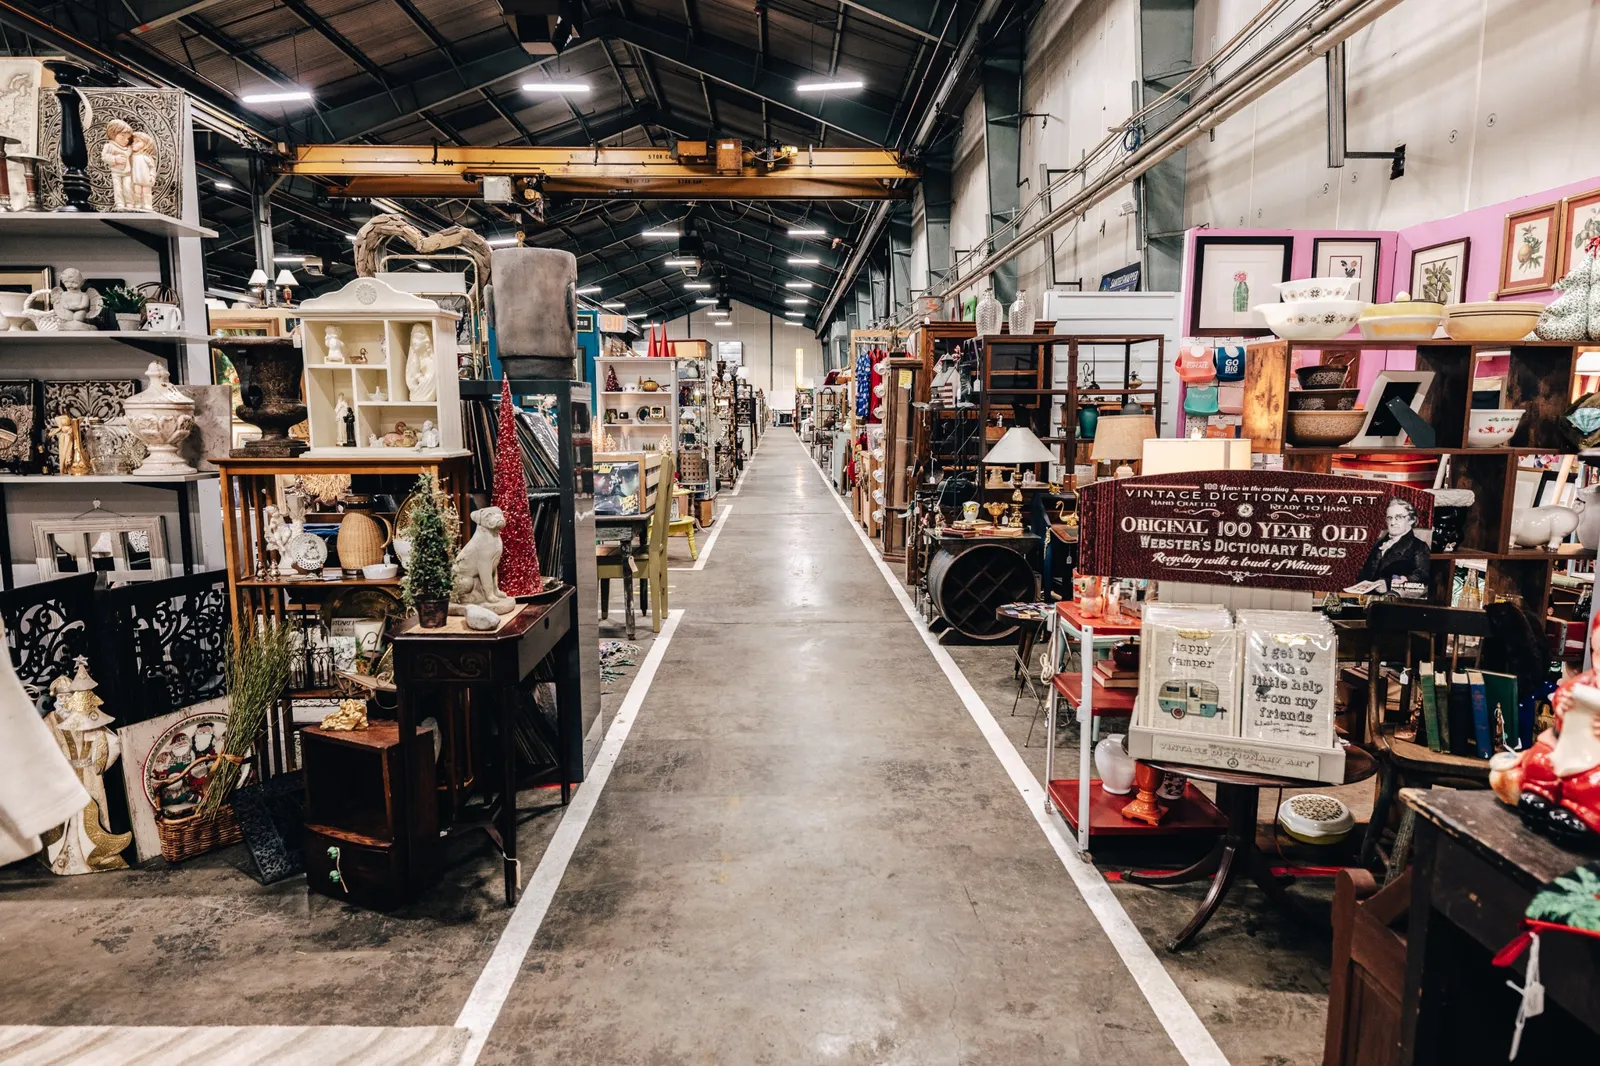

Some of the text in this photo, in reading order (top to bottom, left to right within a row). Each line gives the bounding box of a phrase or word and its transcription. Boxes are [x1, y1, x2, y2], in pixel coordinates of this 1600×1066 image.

[1126, 489, 1377, 505] VINTAGE DICTIONARY ART
[1220, 484, 1240, 492] Years
[1121, 516, 1368, 542] ORIGINAL 100 YEAR OLD
[1140, 534, 1347, 558] WEBSTER'S DICTIONARY PAGES
[1152, 551, 1204, 569] Recycling
[1204, 555, 1230, 566] with
[1240, 556, 1271, 567] touch
[1271, 558, 1288, 571] of
[1286, 559, 1333, 576] Whimsy
[1404, 582, 1425, 590] AMERICA
[1168, 656, 1215, 670] Camper
[1261, 645, 1316, 663] I get by
[1300, 666, 1309, 676] a
[1252, 674, 1324, 695] little help
[1255, 691, 1318, 710] from my
[1259, 706, 1313, 723] friends
[1160, 742, 1208, 755] VINTAGE
[1212, 749, 1282, 765] DICTIONARY
